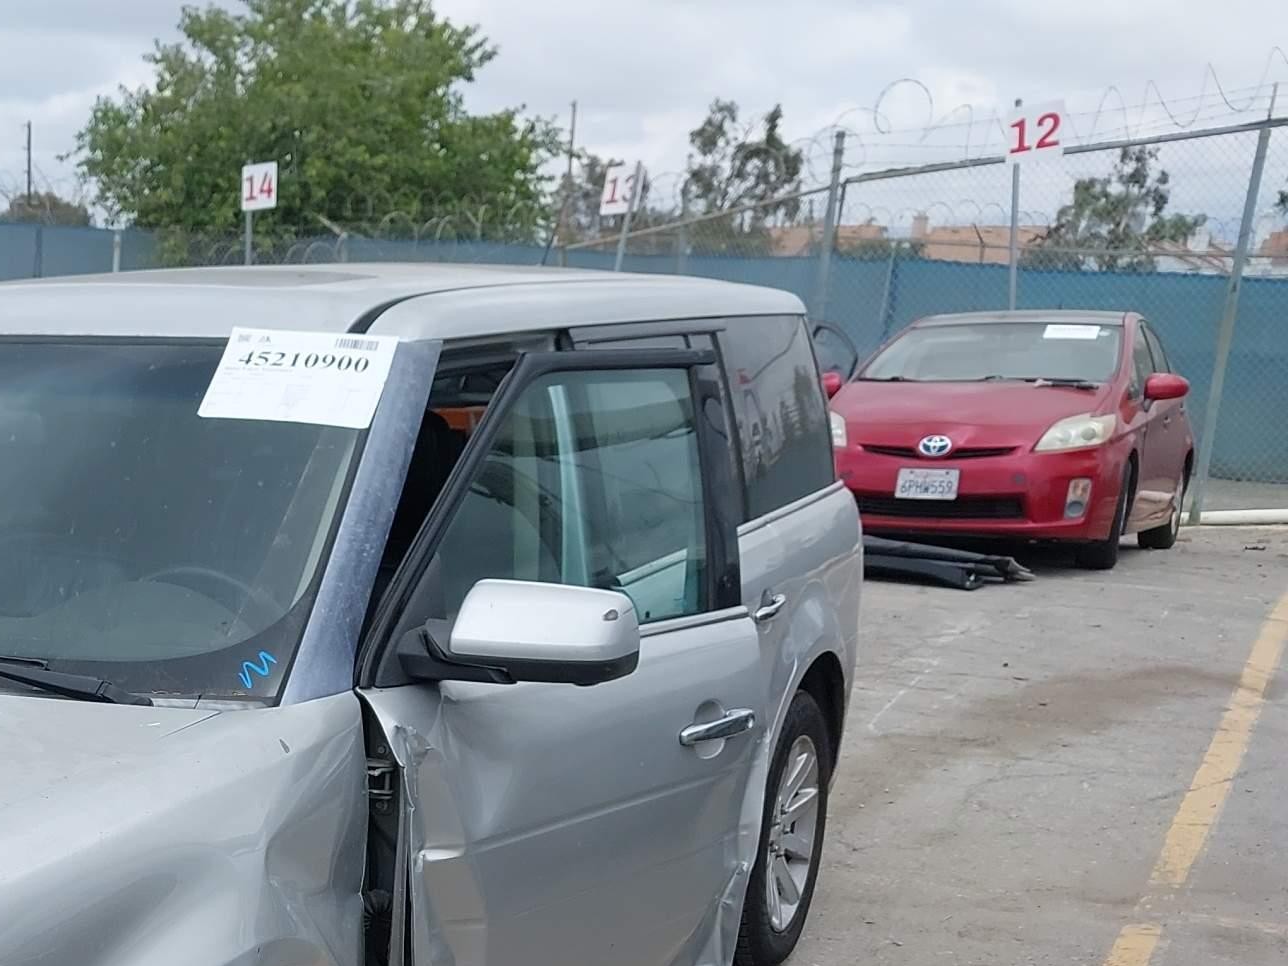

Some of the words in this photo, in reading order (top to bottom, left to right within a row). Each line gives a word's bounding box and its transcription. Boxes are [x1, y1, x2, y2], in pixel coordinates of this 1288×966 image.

[1010, 112, 1060, 154] 12
[245, 171, 273, 202] 14
[238, 350, 369, 373] 45210900
